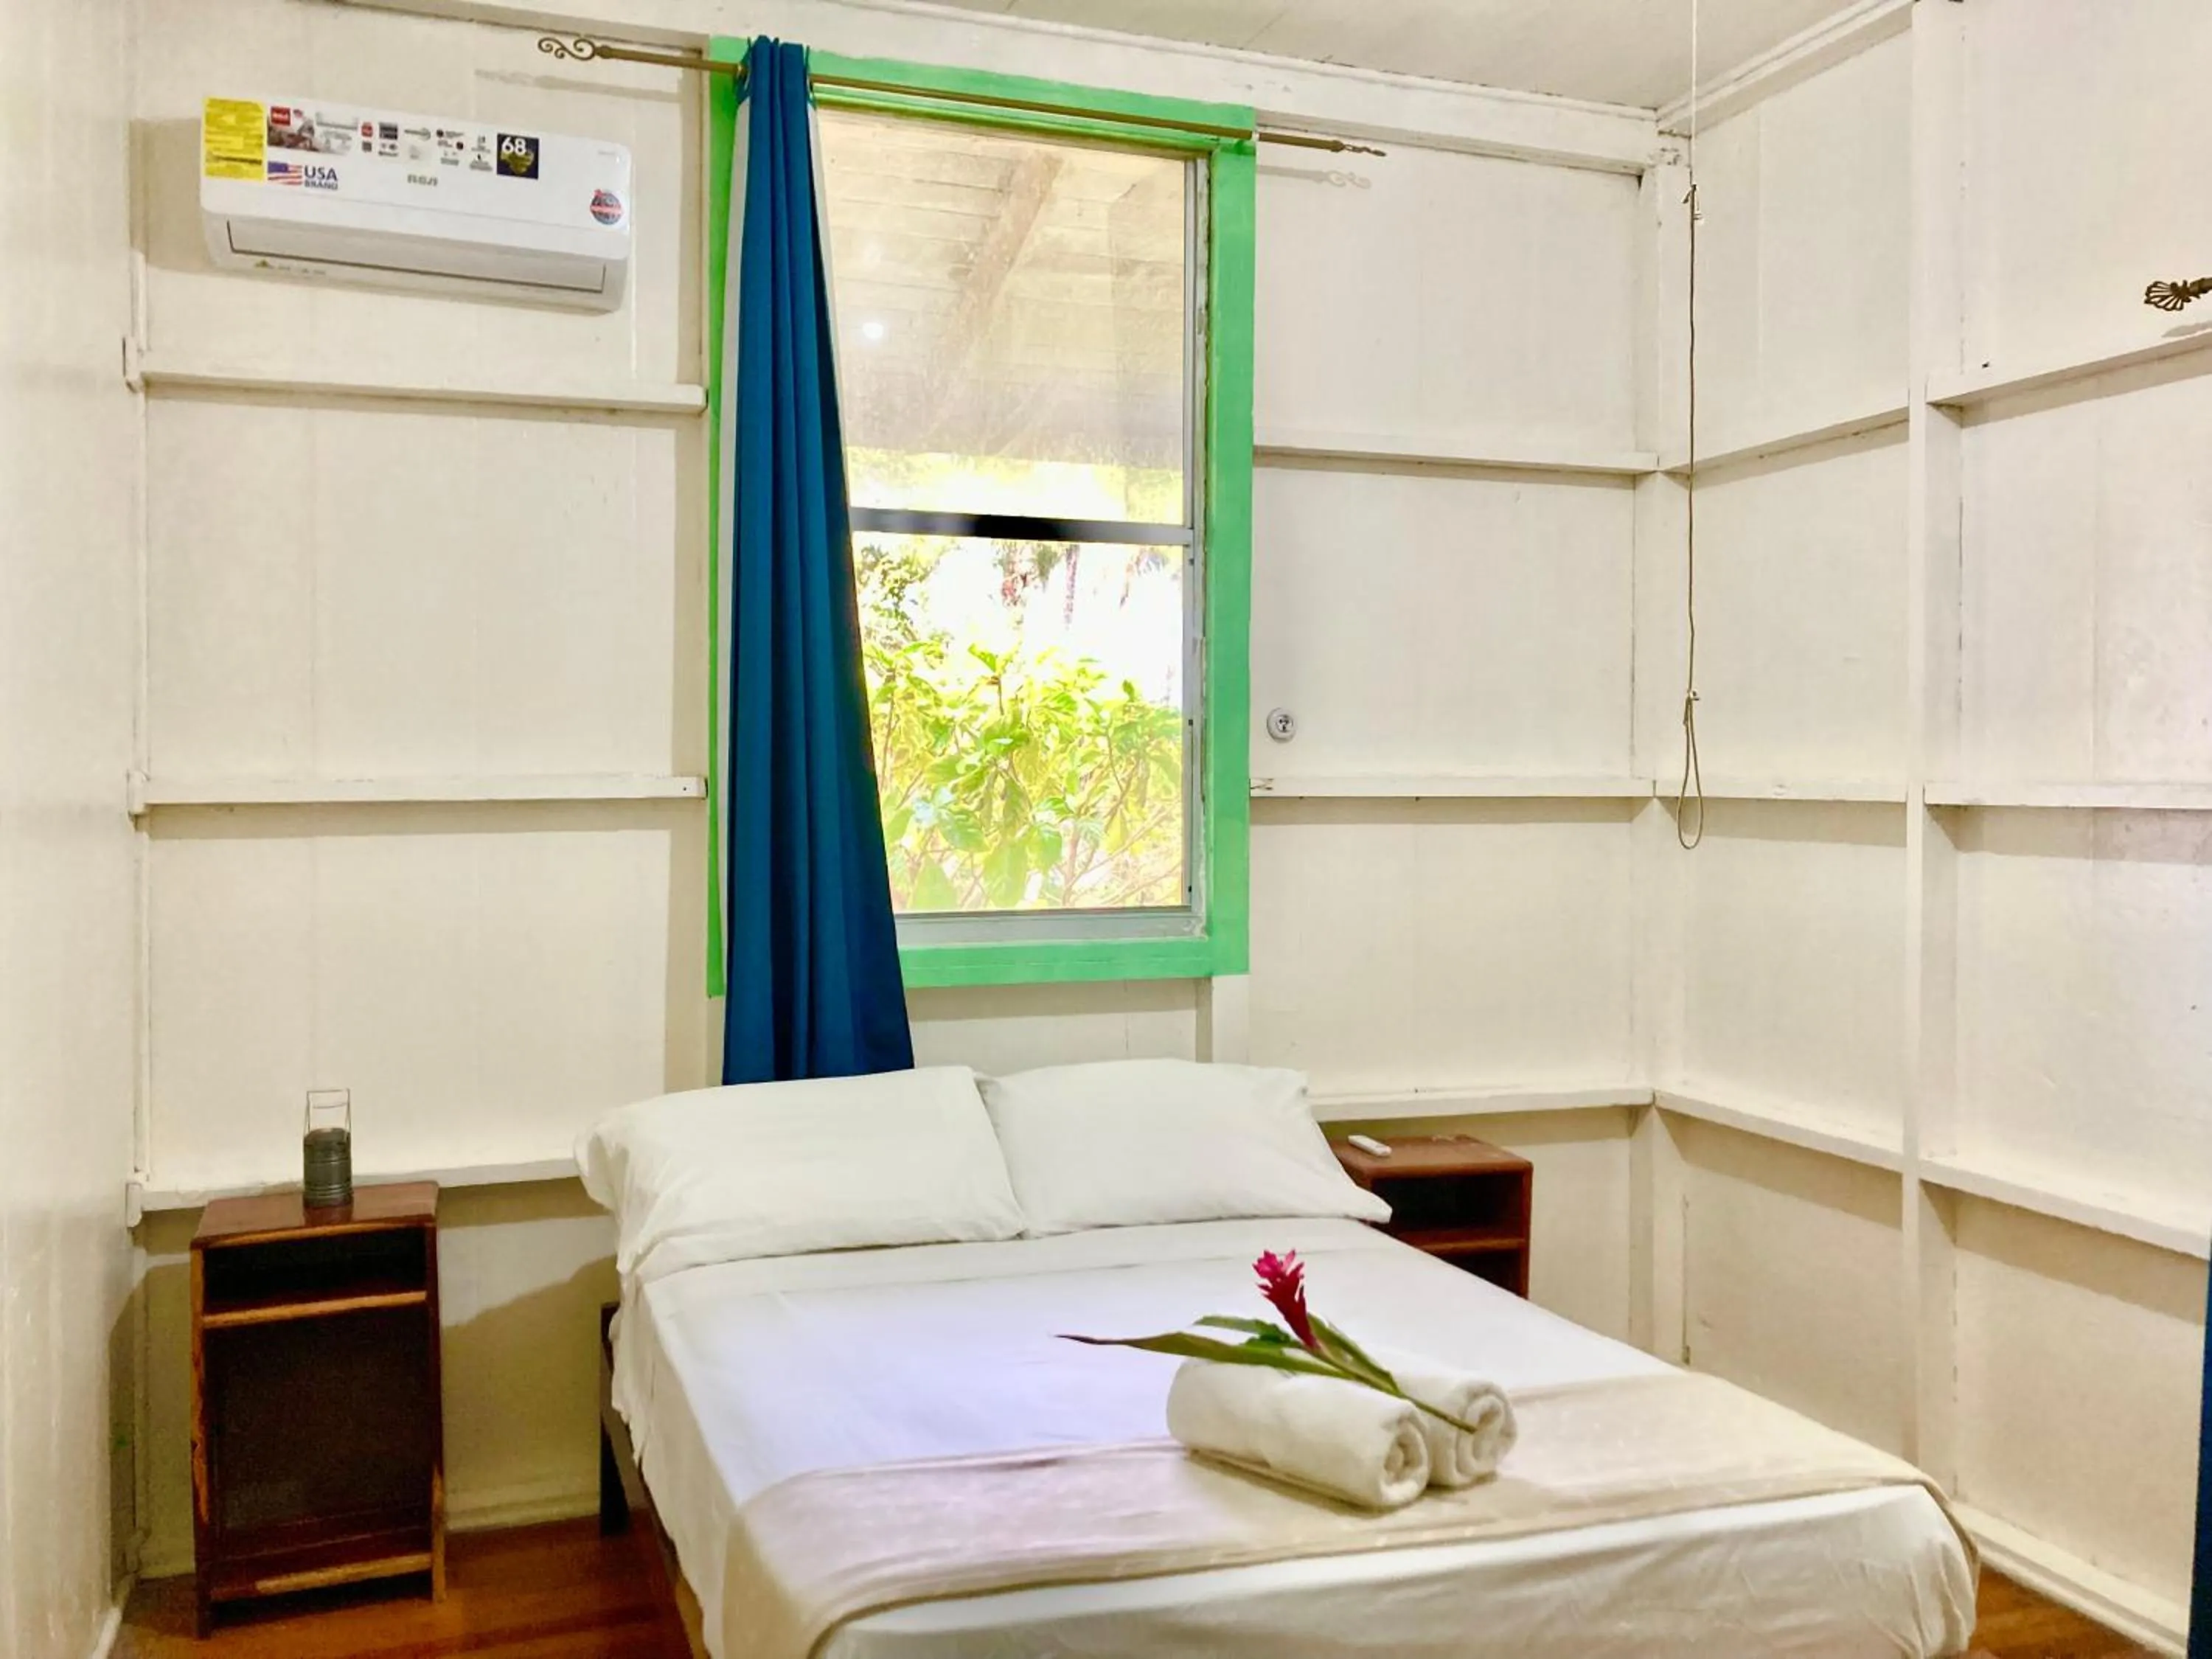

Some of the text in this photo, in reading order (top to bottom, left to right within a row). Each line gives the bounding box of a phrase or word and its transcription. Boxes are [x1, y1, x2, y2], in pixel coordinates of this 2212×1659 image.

[501, 136, 526, 156] 68
[305, 165, 338, 181] USA
[305, 179, 338, 189] BRAND
